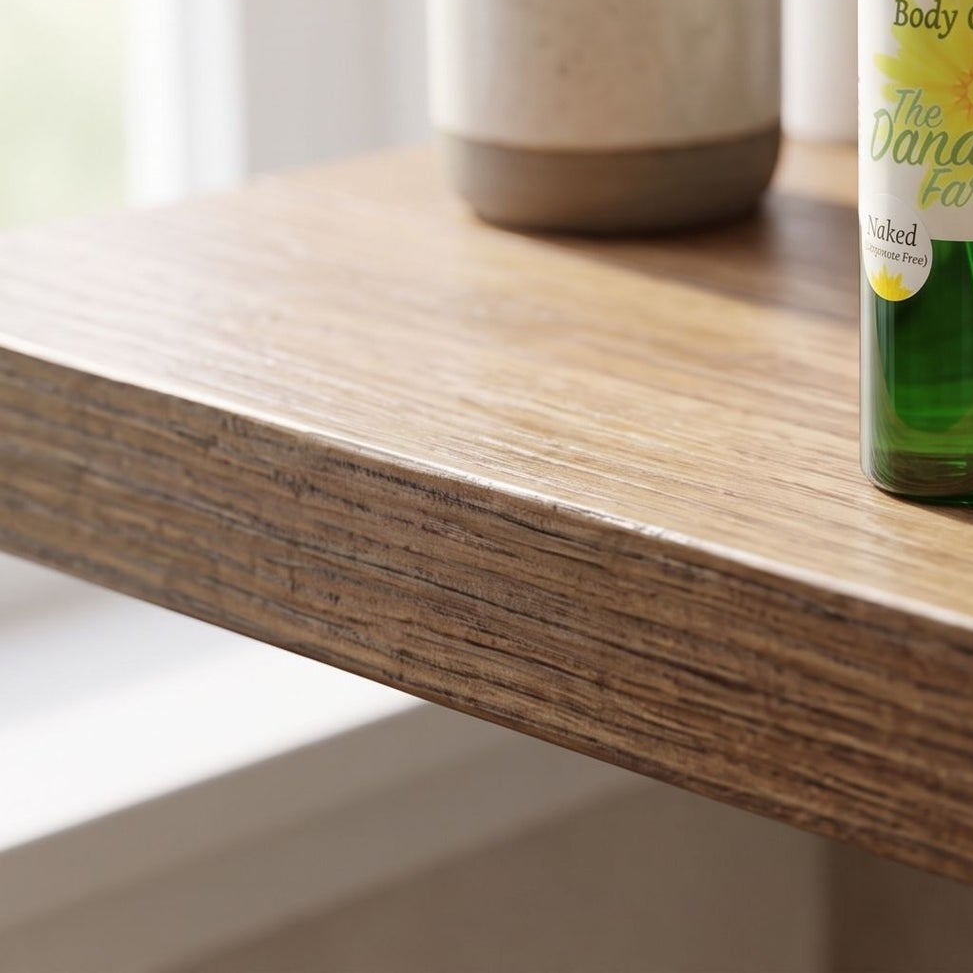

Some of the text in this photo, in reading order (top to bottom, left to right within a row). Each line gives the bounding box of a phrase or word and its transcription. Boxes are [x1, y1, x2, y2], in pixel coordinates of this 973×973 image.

[893, 89, 944, 128] The
[867, 214, 918, 247] Naked
[902, 252, 928, 268] Free)
